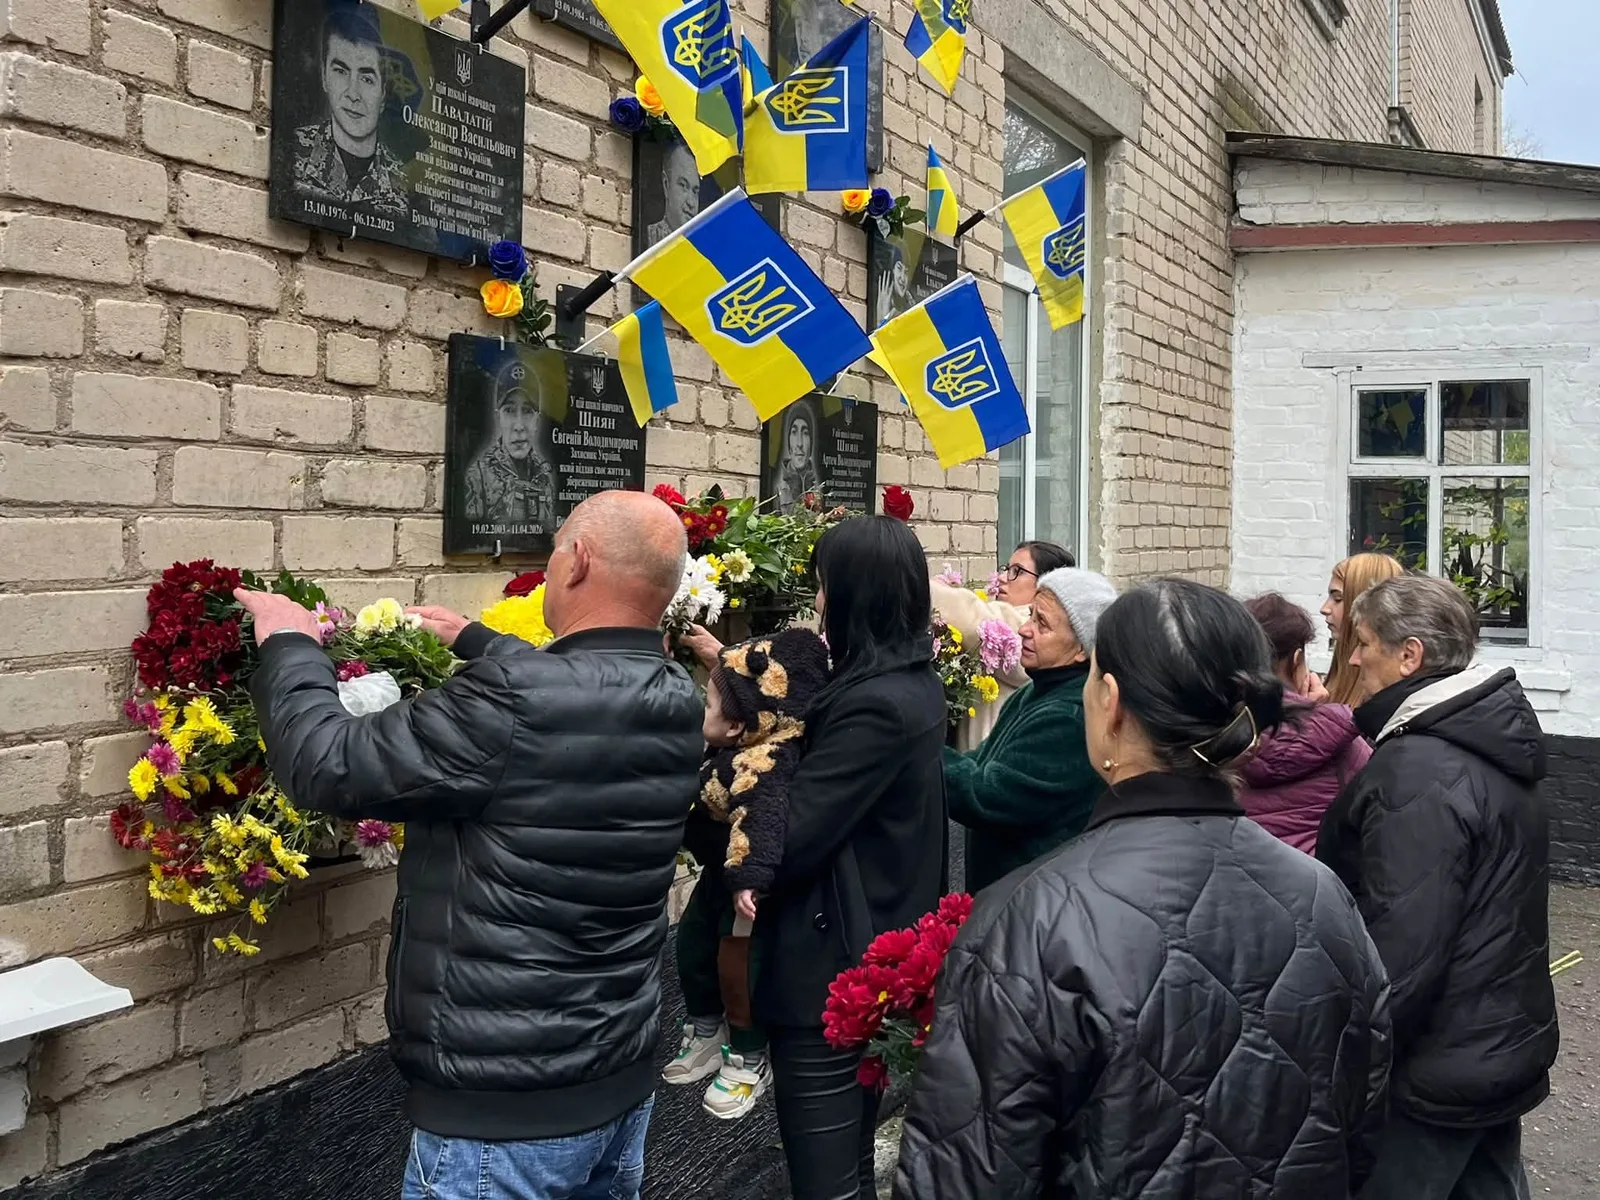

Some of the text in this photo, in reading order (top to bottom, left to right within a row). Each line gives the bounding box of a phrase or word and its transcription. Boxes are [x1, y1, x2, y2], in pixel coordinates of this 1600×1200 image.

[402, 105, 517, 159] Олександр Васильович
[428, 135, 463, 158] Захисник
[304, 199, 348, 221] 13.10.1976
[353, 212, 395, 232] 06.12.2023
[412, 209, 438, 228] Будьмо
[552, 427, 639, 453] Євгеній Володимирович
